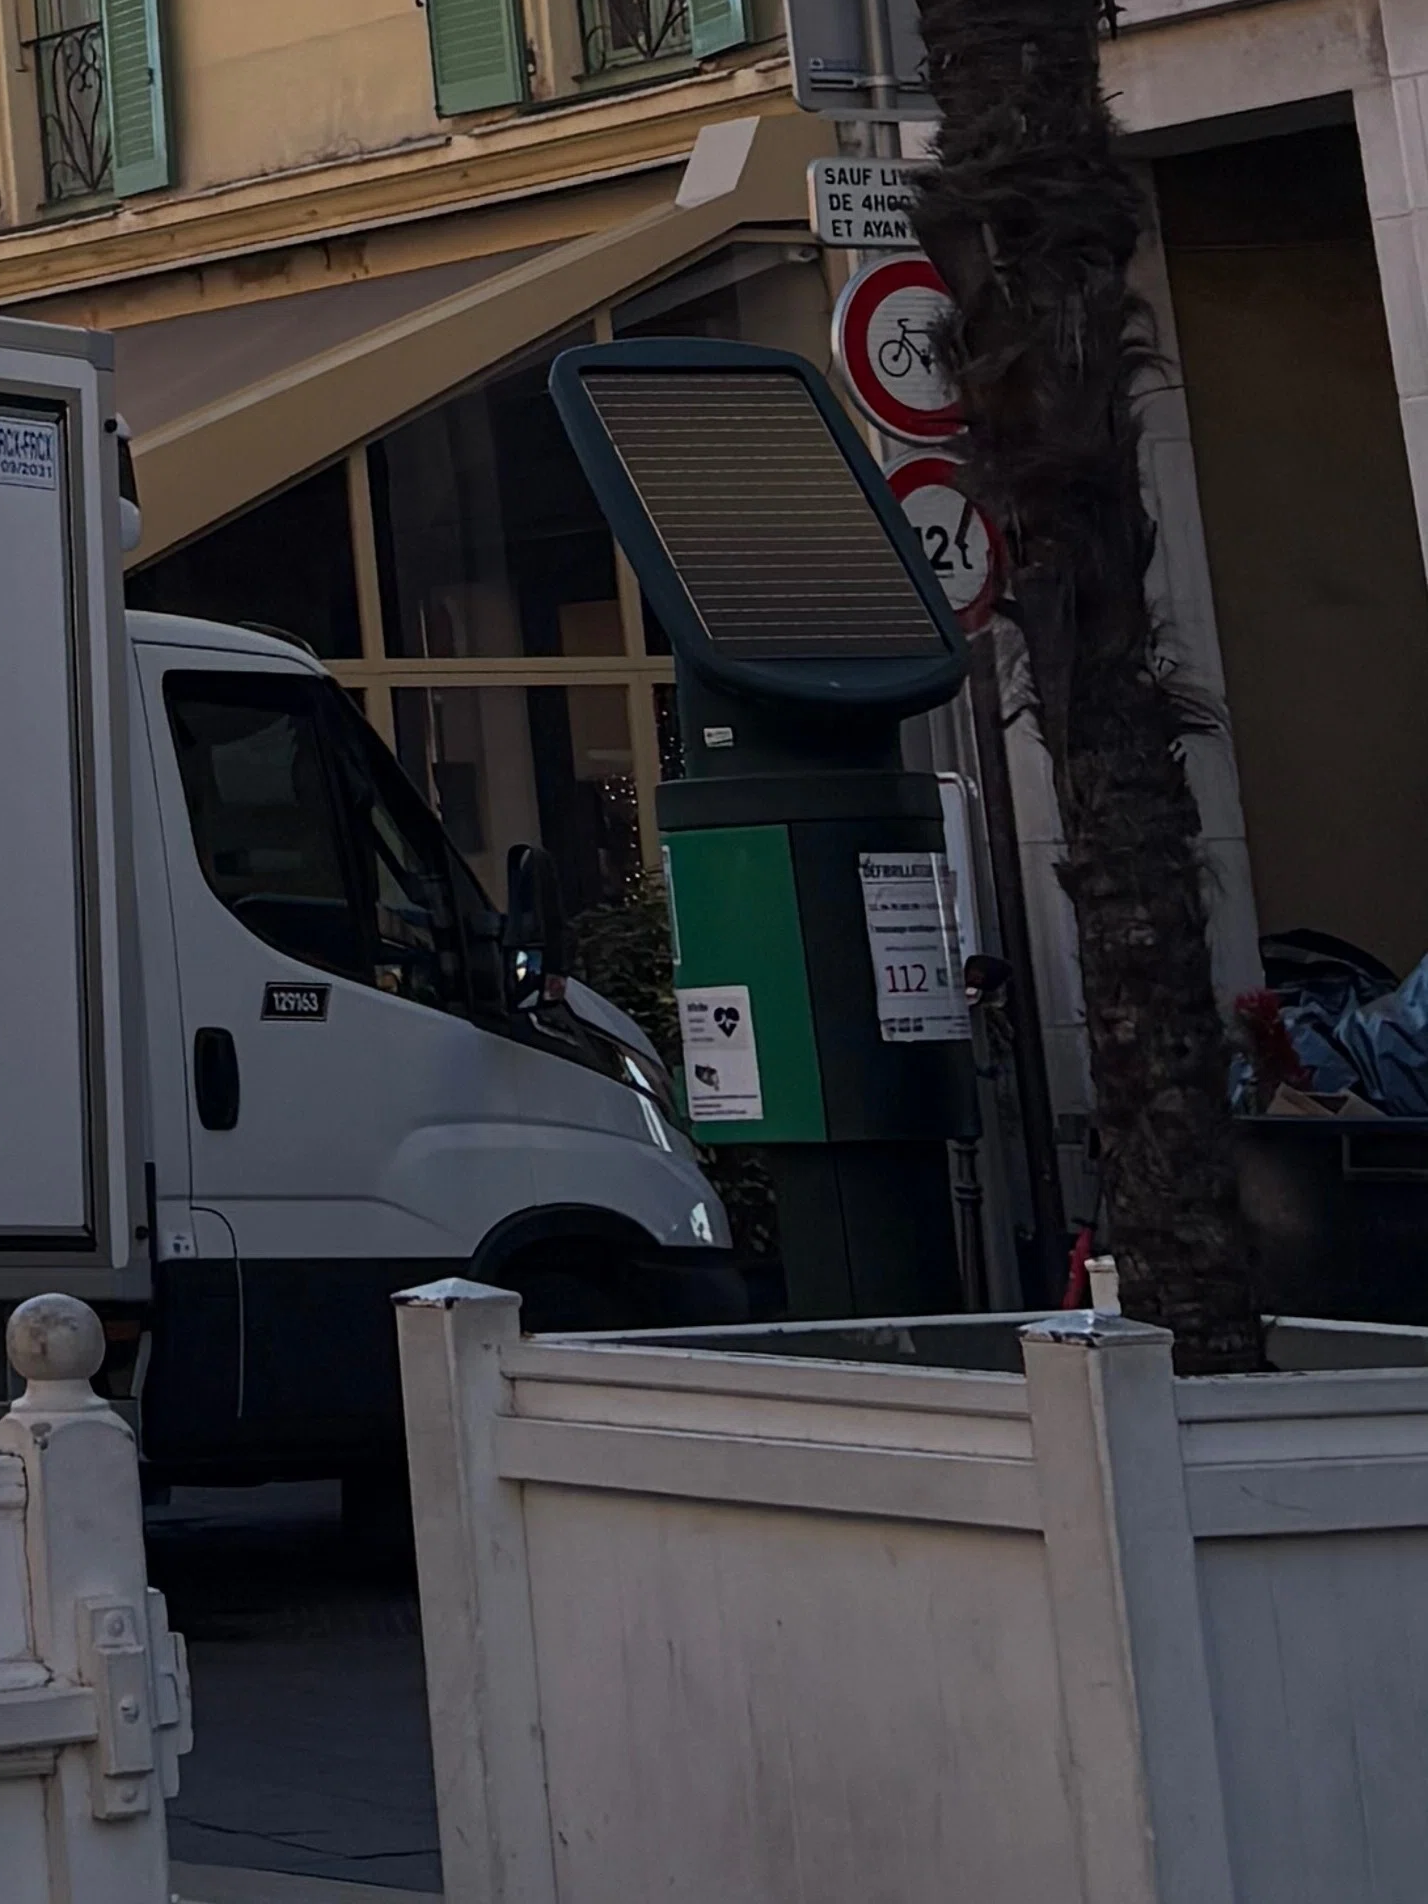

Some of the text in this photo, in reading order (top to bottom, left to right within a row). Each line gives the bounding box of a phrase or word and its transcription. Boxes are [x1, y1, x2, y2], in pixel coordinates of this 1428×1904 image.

[824, 167, 873, 186] SAUF
[828, 193, 853, 212] DE
[831, 219, 853, 238] ET
[885, 963, 929, 994] 112
